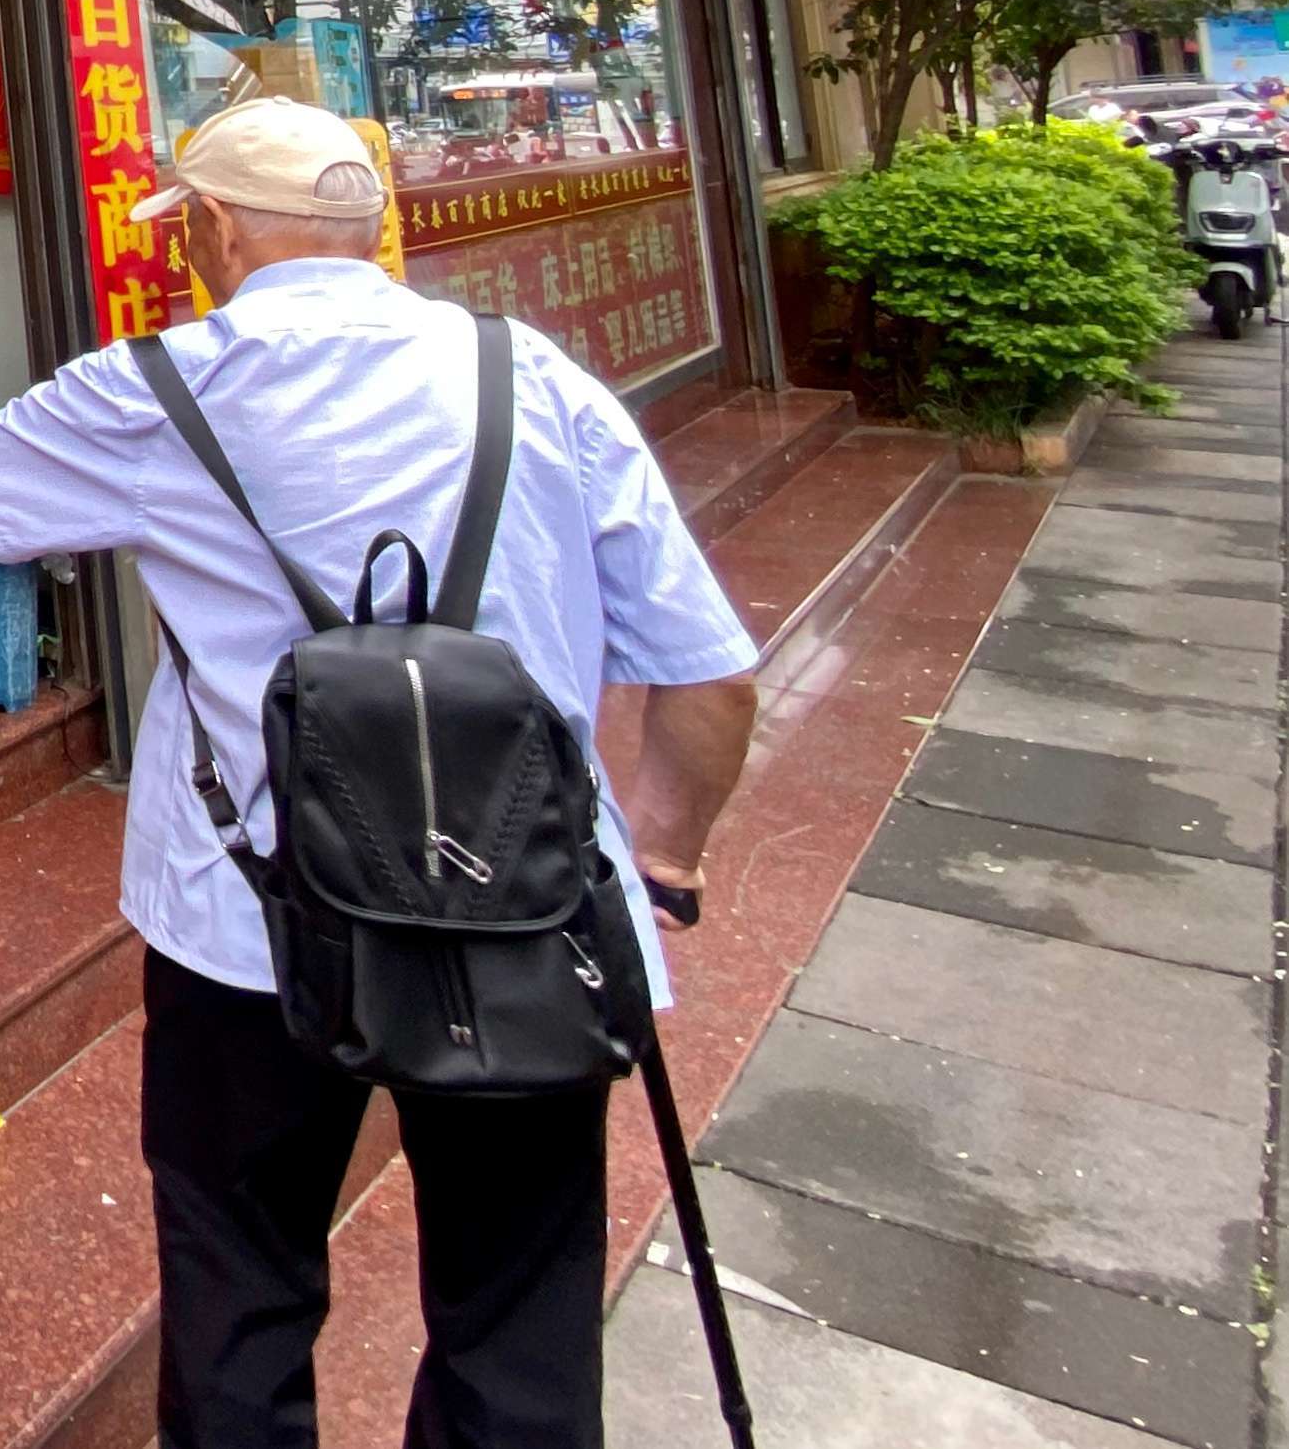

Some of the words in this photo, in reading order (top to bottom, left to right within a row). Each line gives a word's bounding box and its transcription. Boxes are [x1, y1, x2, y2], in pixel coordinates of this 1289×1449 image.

[398, 187, 509, 235] 长春百货商店
